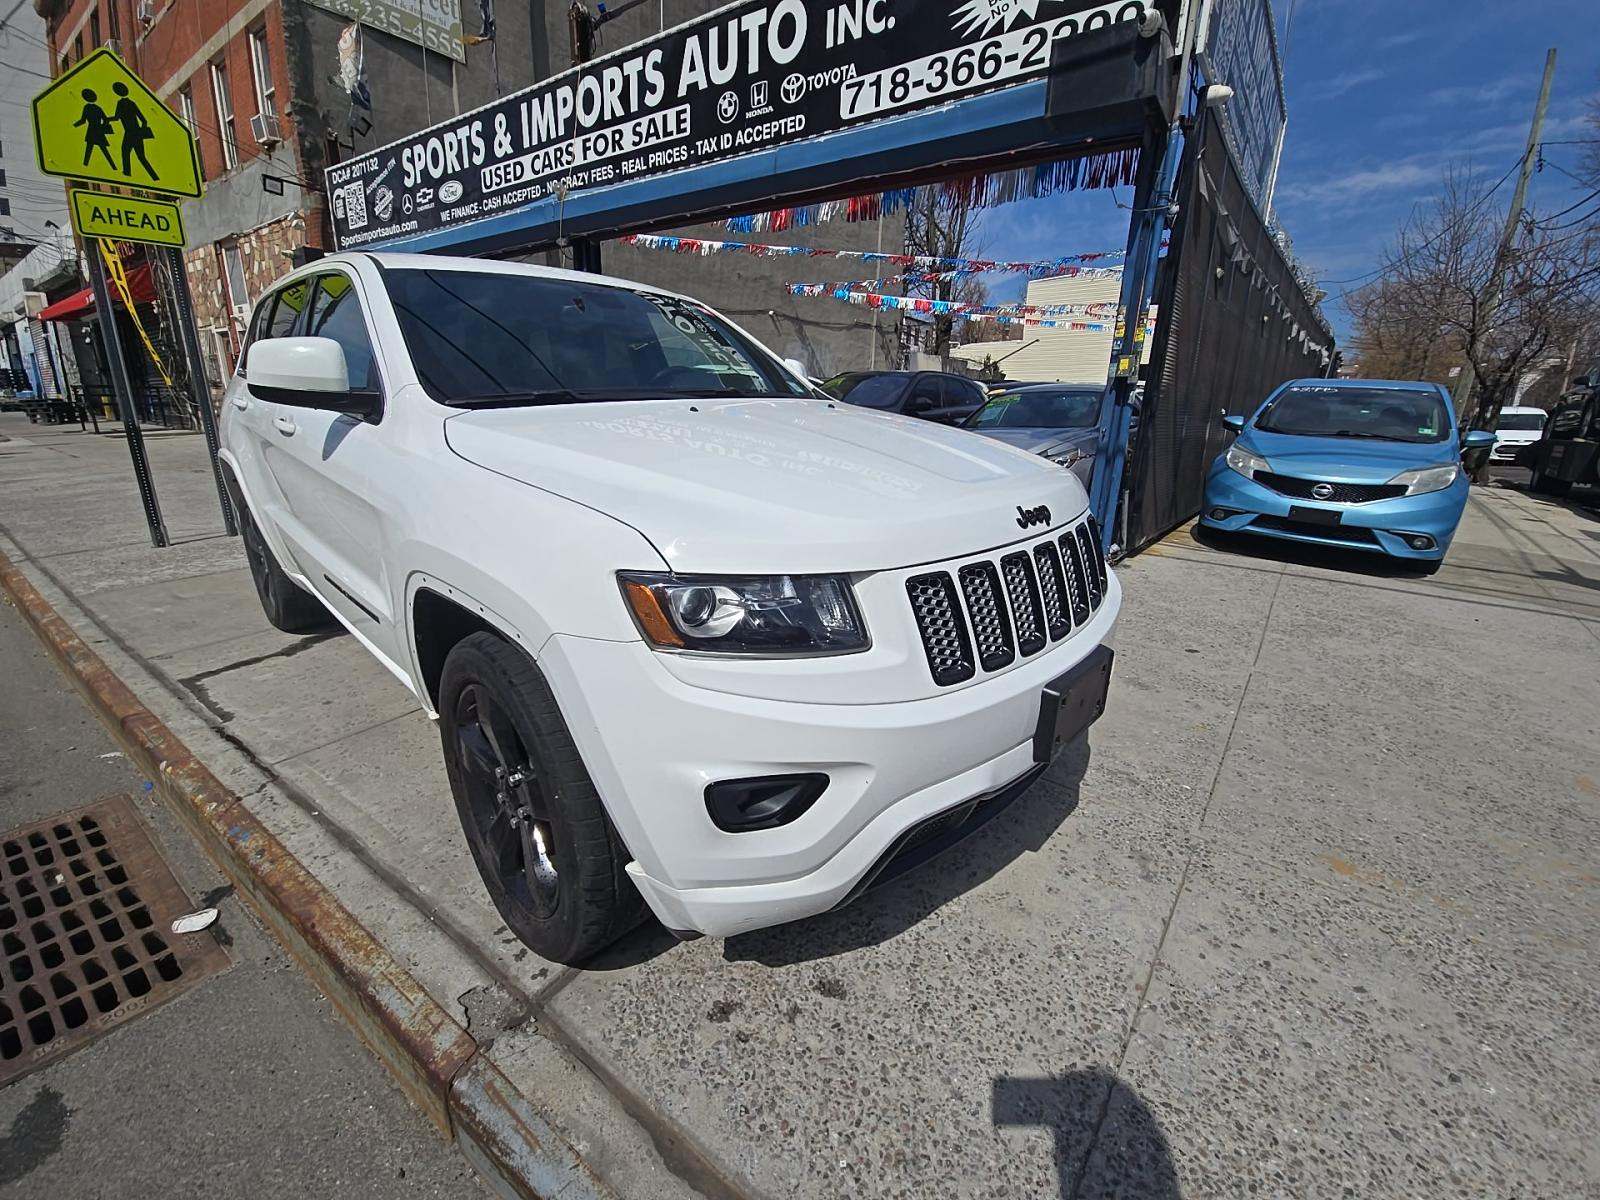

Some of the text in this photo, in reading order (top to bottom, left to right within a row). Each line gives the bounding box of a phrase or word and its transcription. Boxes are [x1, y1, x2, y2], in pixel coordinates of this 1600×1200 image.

[845, 1, 1146, 115] 718-366-2
[806, 62, 858, 92] TOYOTA
[402, 0, 896, 188] SPORTS & IMPORTS AUTO INC.
[745, 105, 774, 119] HONDA
[482, 107, 689, 190] USED CARS FOR SALE
[332, 157, 379, 184] DCA# 2071132
[440, 209, 451, 222] WE
[451, 202, 479, 219] FINANCE
[483, 199, 502, 212] CASH
[502, 185, 541, 206] ACCEPTED
[562, 173, 589, 190] CRAZY
[591, 166, 614, 182] FEES
[621, 158, 644, 176] REAL
[649, 145, 688, 167] PRICES
[695, 137, 717, 156] TAX
[720, 133, 733, 146] ID
[735, 114, 806, 147] ACCEPTED
[91, 205, 171, 232] AHEAD
[340, 220, 418, 248] Sportsimportsauto.com
[1016, 505, 1052, 529] Jeep
